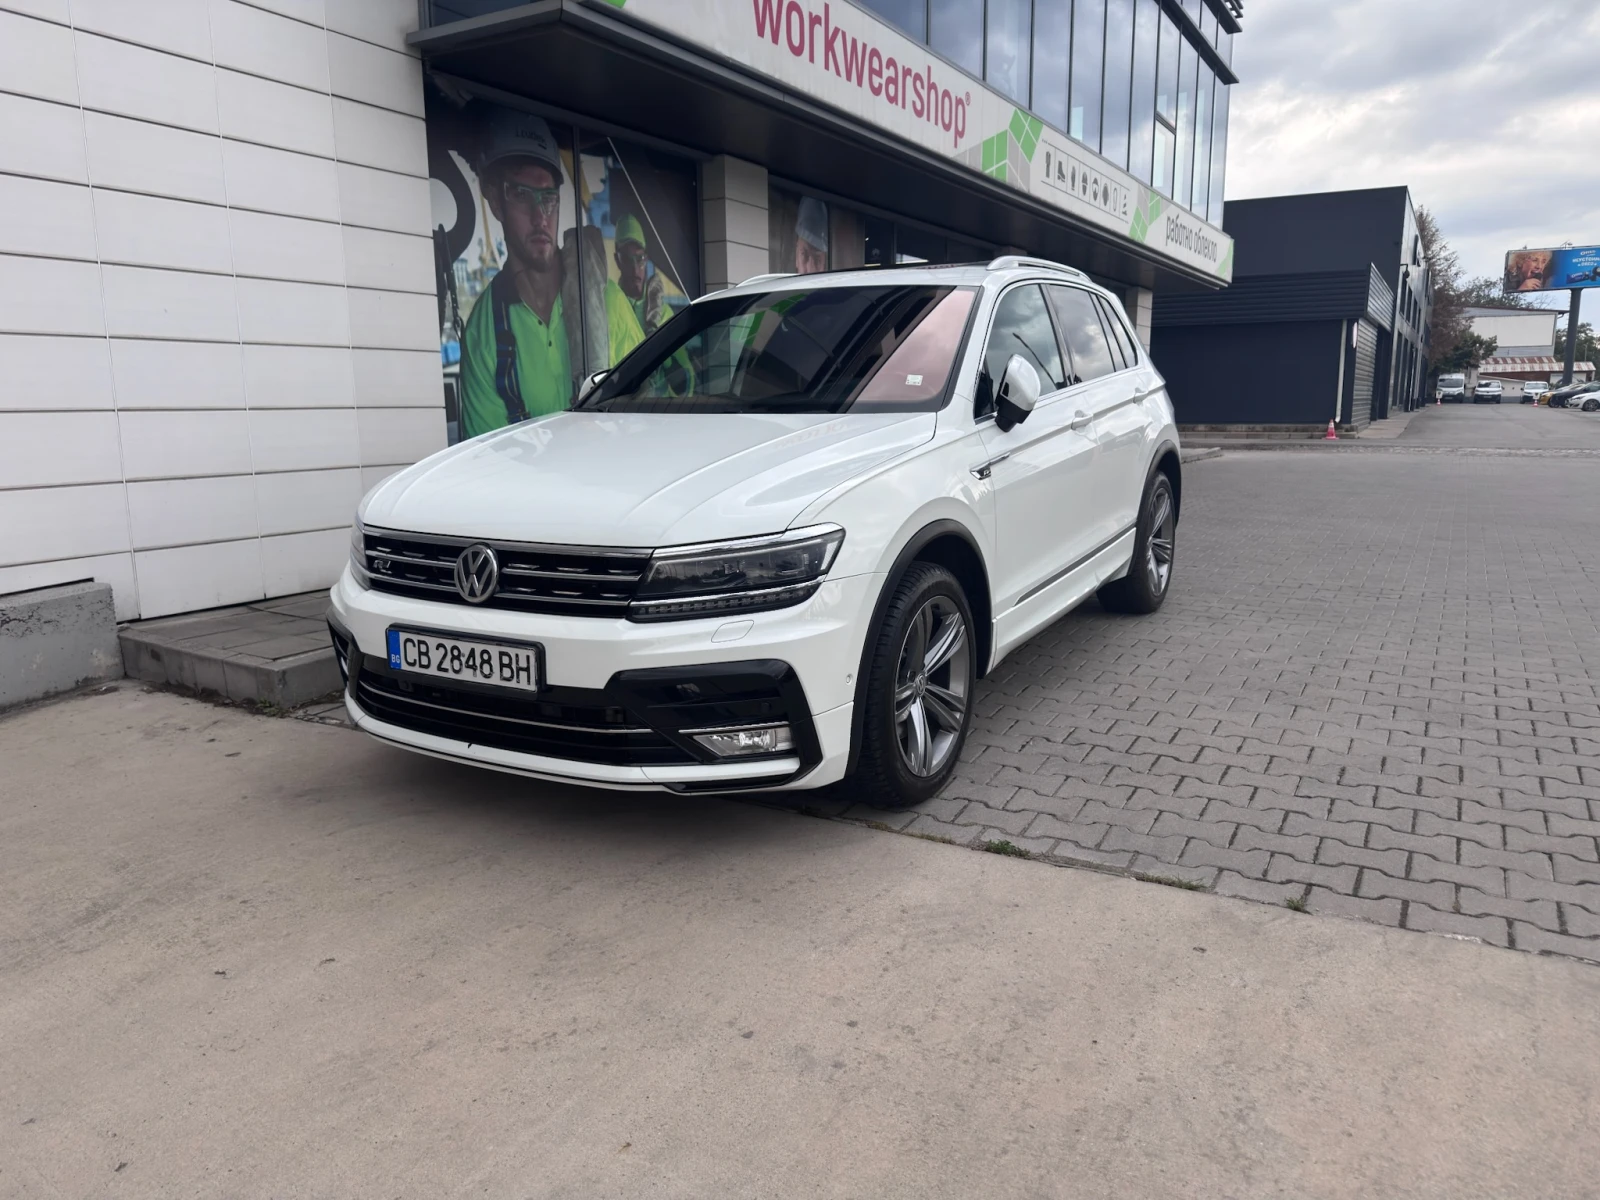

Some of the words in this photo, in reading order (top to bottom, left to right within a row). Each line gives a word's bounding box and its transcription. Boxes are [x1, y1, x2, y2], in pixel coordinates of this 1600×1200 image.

[1165, 213, 1193, 251] работно
[1193, 227, 1218, 263] облекло
[391, 653, 401, 664] BG
[435, 642, 494, 679] 2848
